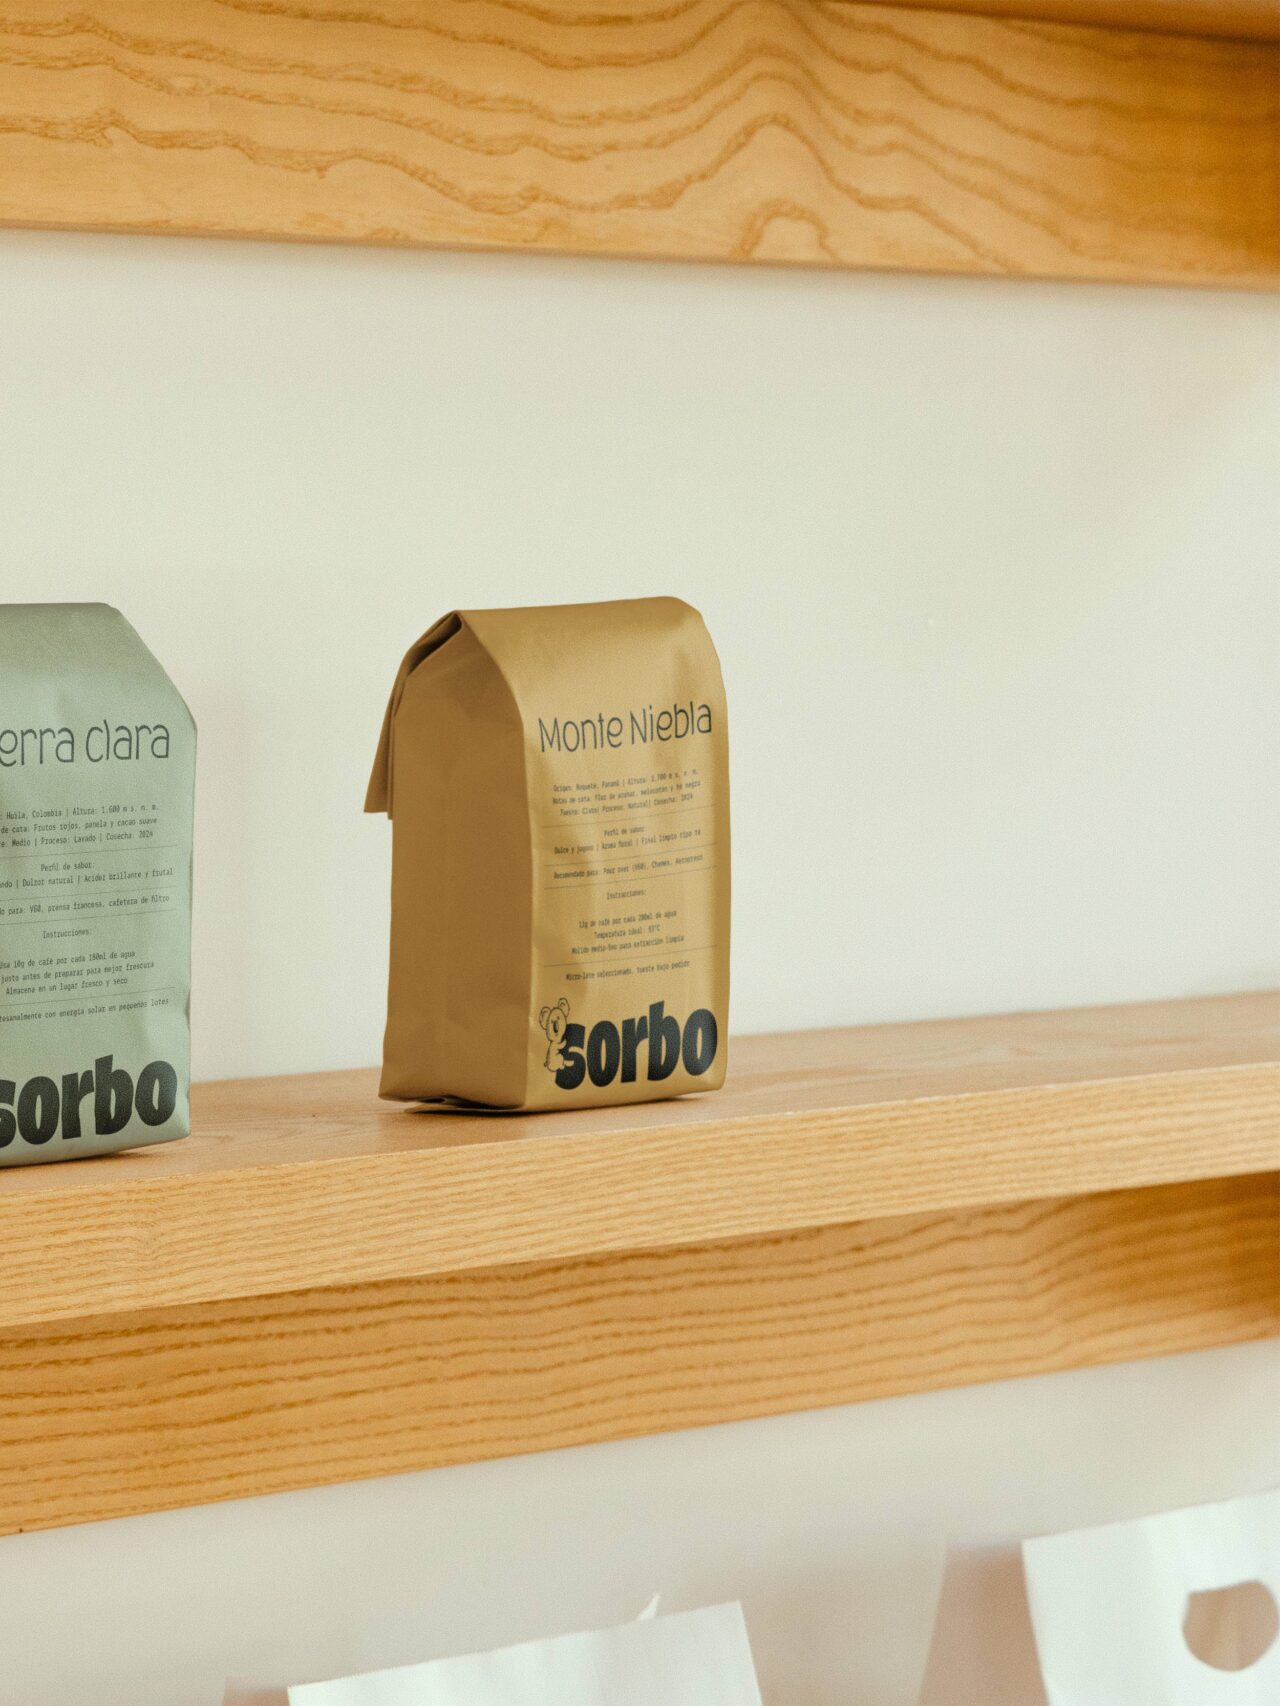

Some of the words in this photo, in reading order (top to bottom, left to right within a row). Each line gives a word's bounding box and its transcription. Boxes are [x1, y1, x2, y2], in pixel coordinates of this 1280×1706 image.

[85, 719, 170, 762] clara
[538, 713, 623, 753] Monte
[630, 701, 712, 745] Niebla
[555, 1000, 717, 1090] sorbo
